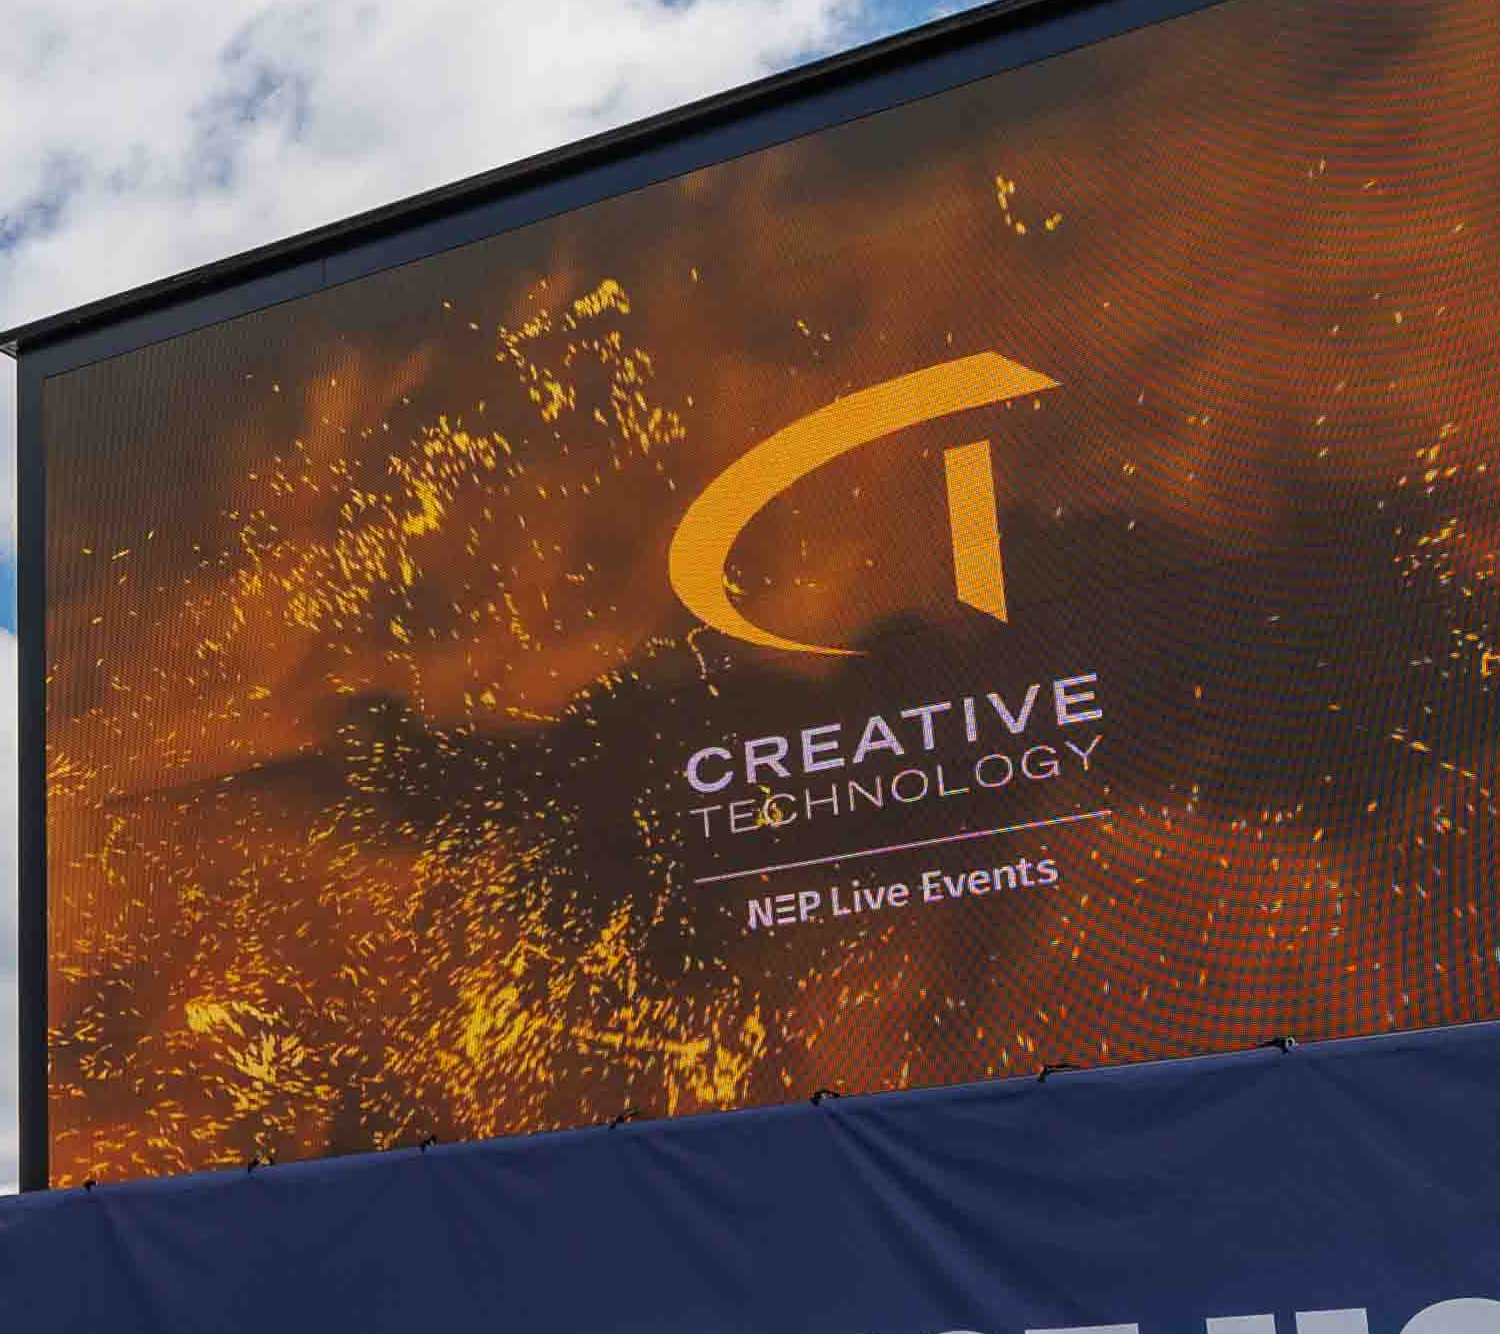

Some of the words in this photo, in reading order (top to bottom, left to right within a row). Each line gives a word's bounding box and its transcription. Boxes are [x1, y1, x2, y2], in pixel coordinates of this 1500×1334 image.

[686, 672, 1102, 794] CREATIVE
[689, 735, 1103, 838] TECHNOLOGY
[747, 890, 822, 929] NEP
[831, 879, 910, 916] Live
[922, 857, 1059, 902] Events
